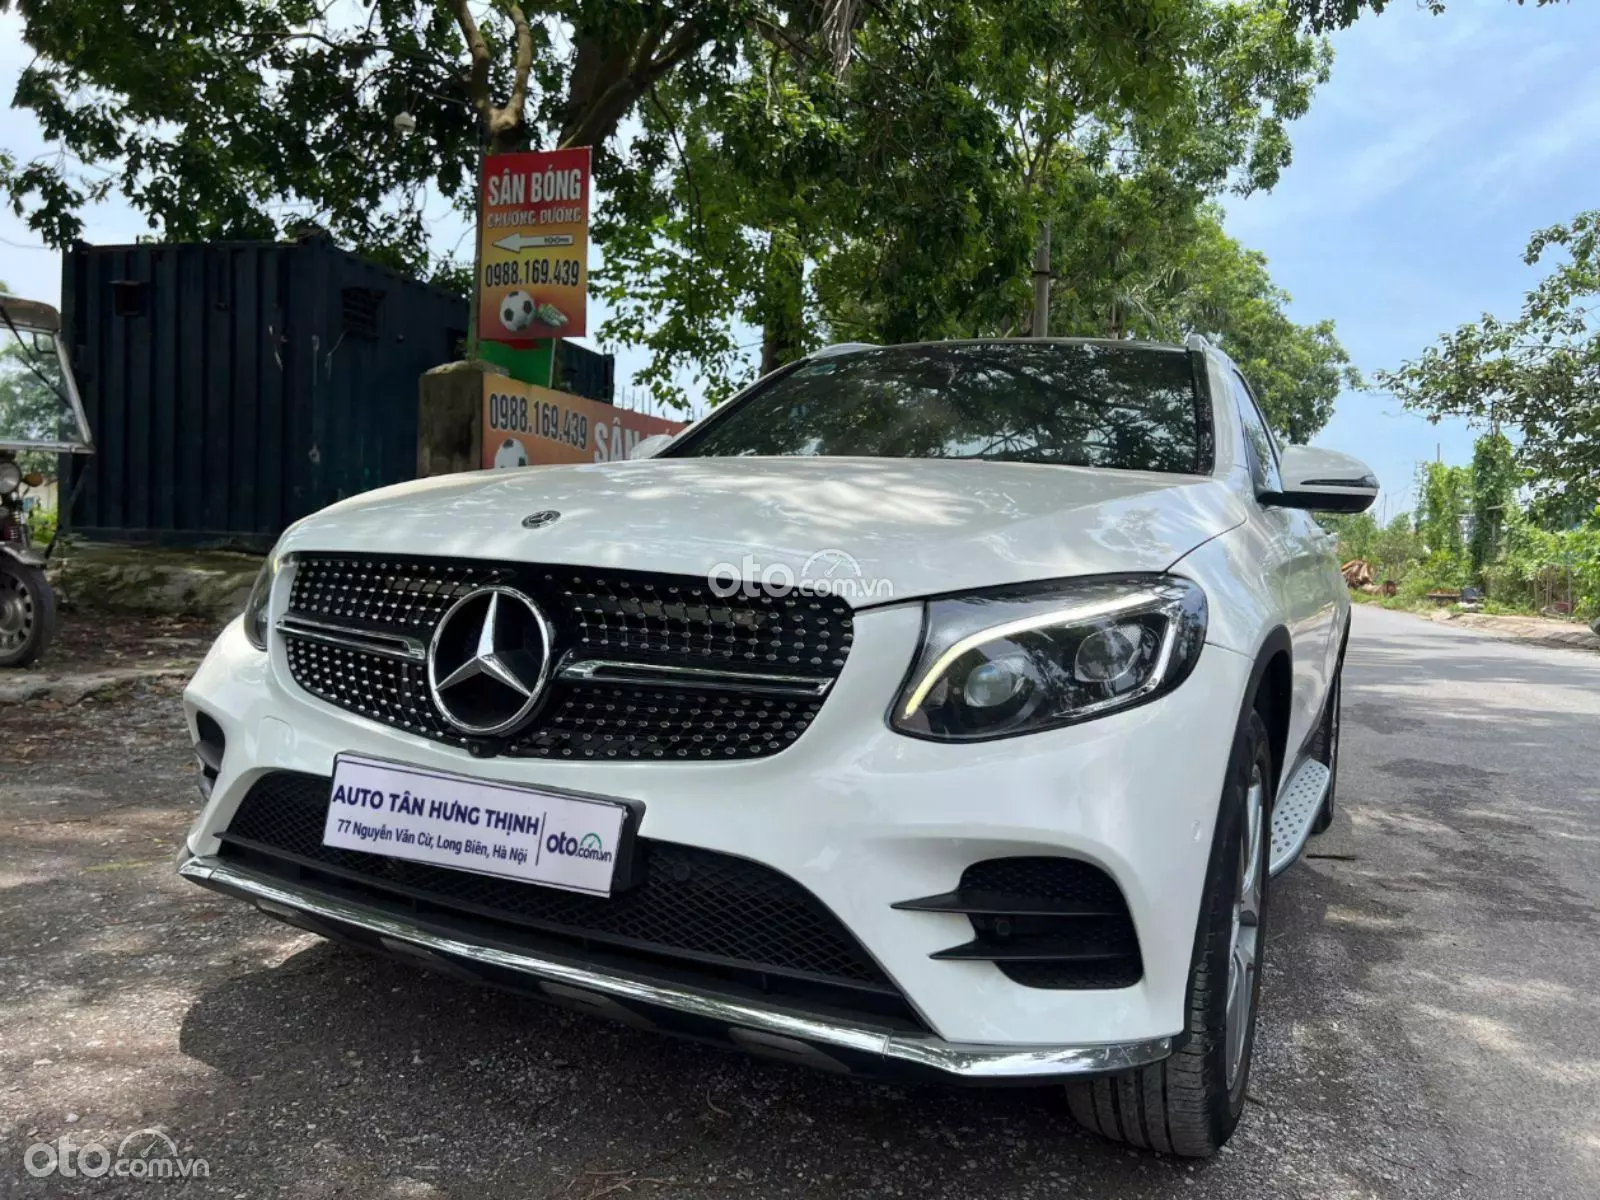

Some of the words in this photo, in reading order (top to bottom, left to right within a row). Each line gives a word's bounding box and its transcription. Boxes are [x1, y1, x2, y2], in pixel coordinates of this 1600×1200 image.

[488, 168, 525, 206] SÂN
[531, 164, 582, 203] BÓNG
[485, 259, 580, 288] 0988.169.439
[489, 393, 588, 450] 0988.169.439
[332, 784, 384, 810] AUTO
[389, 790, 426, 817] TÂN
[429, 799, 481, 826] HƯNG
[485, 808, 540, 836] THỊNH
[337, 818, 352, 834] 77
[352, 822, 393, 842] Nguyễn
[395, 828, 415, 844] Văn
[436, 834, 462, 855] Long
[464, 839, 490, 859] Biên,
[492, 843, 507, 859] Hà
[509, 847, 529, 865] Nội
